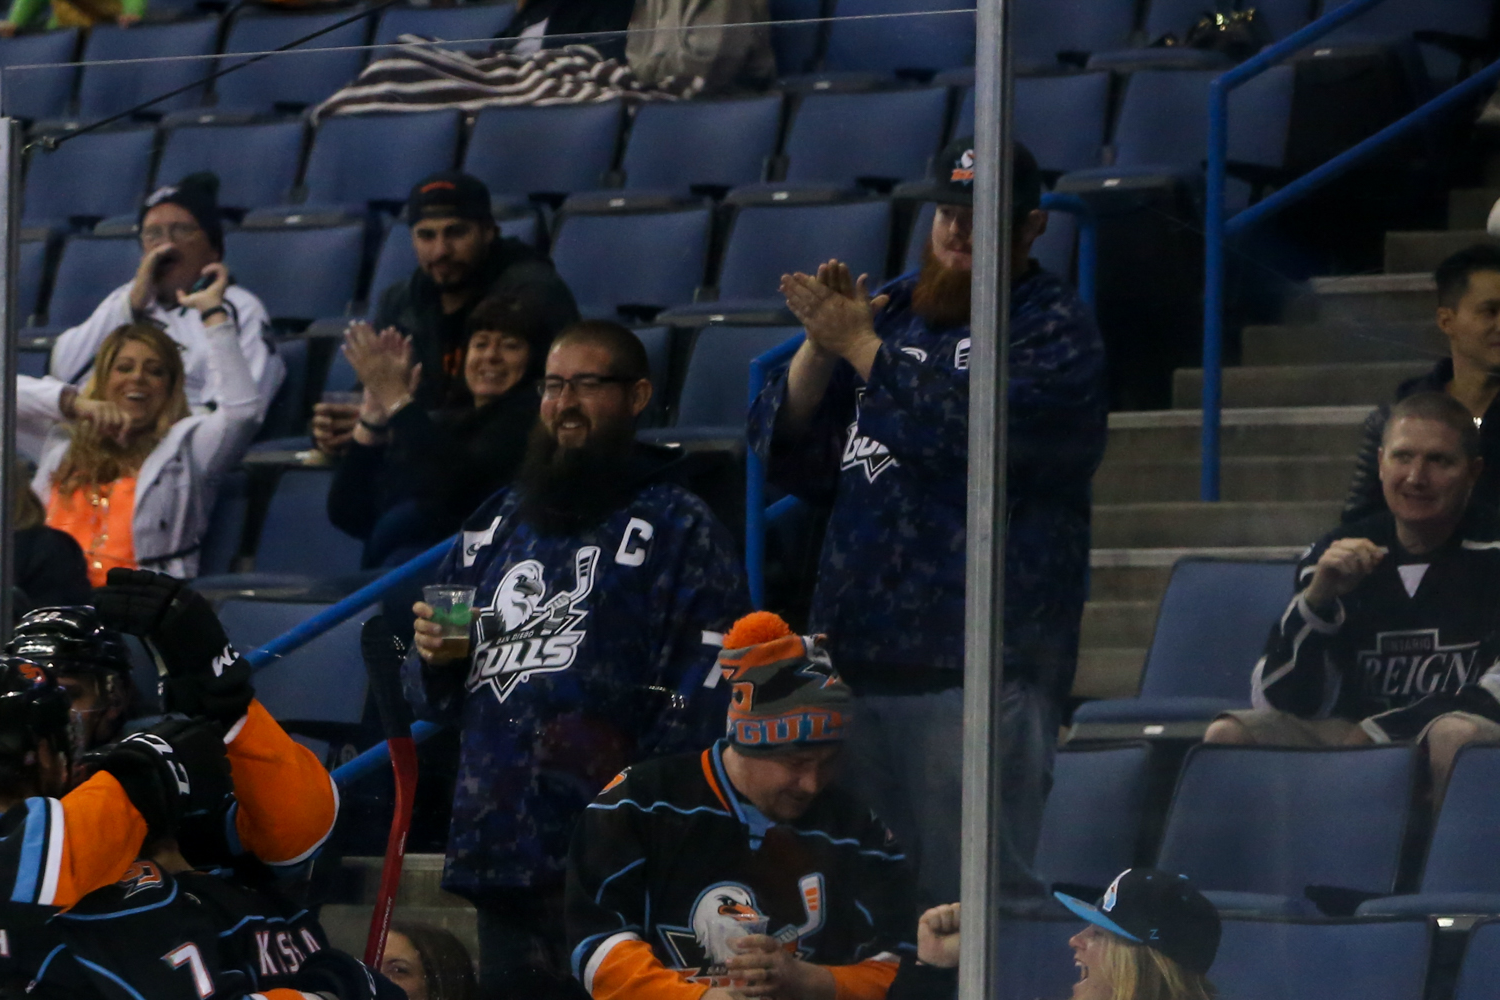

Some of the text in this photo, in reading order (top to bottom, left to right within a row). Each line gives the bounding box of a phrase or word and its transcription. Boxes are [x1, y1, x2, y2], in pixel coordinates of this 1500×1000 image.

[614, 517, 653, 567] C
[467, 630, 587, 689] GULLS
[496, 630, 535, 645] SAN DIEGO
